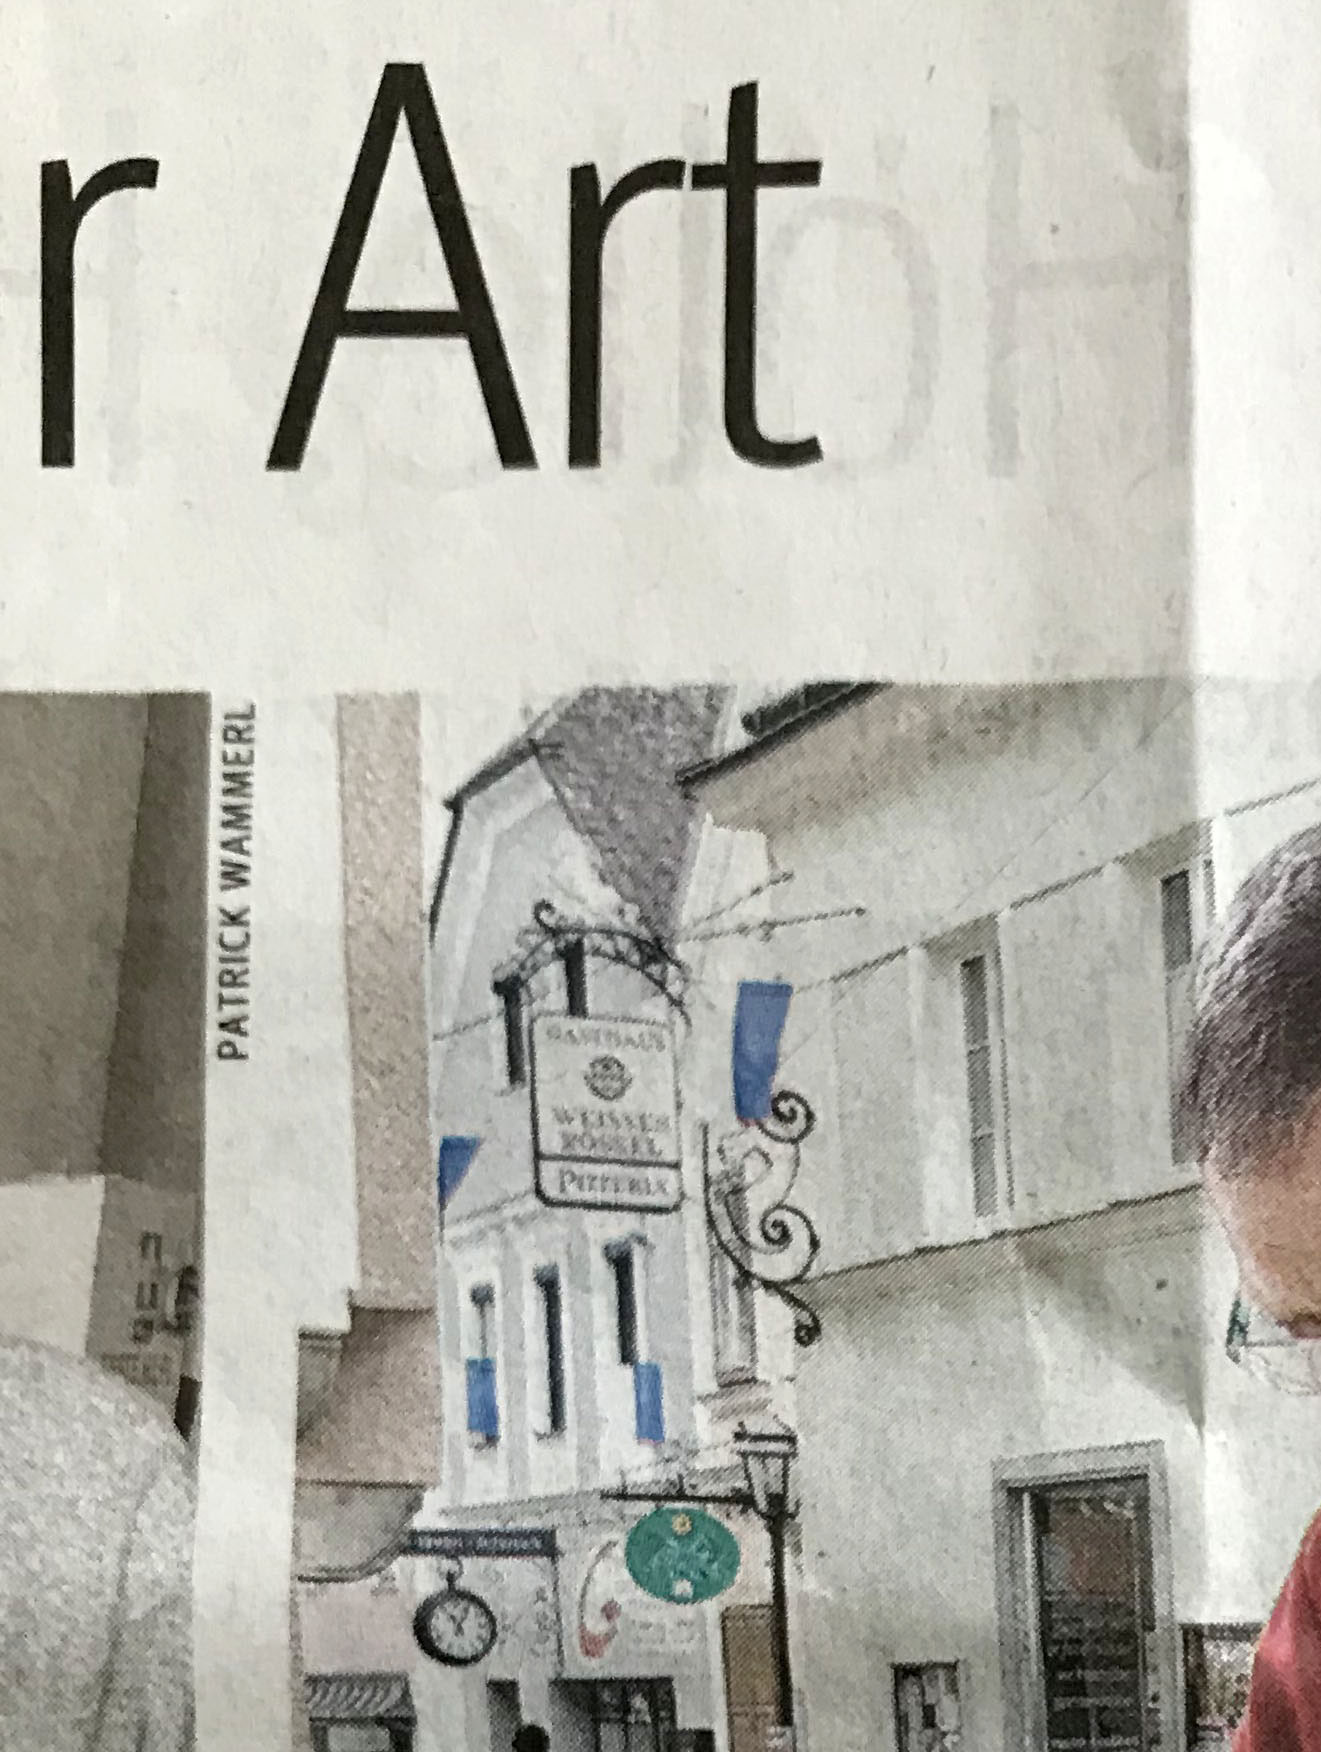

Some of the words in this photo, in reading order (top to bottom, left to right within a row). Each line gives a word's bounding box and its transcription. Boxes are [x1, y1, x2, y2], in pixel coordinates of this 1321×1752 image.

[40, 157, 160, 469] r
[265, 62, 823, 471] Art
[219, 702, 257, 892] WAMMERL
[216, 906, 251, 1062] PATRICK
